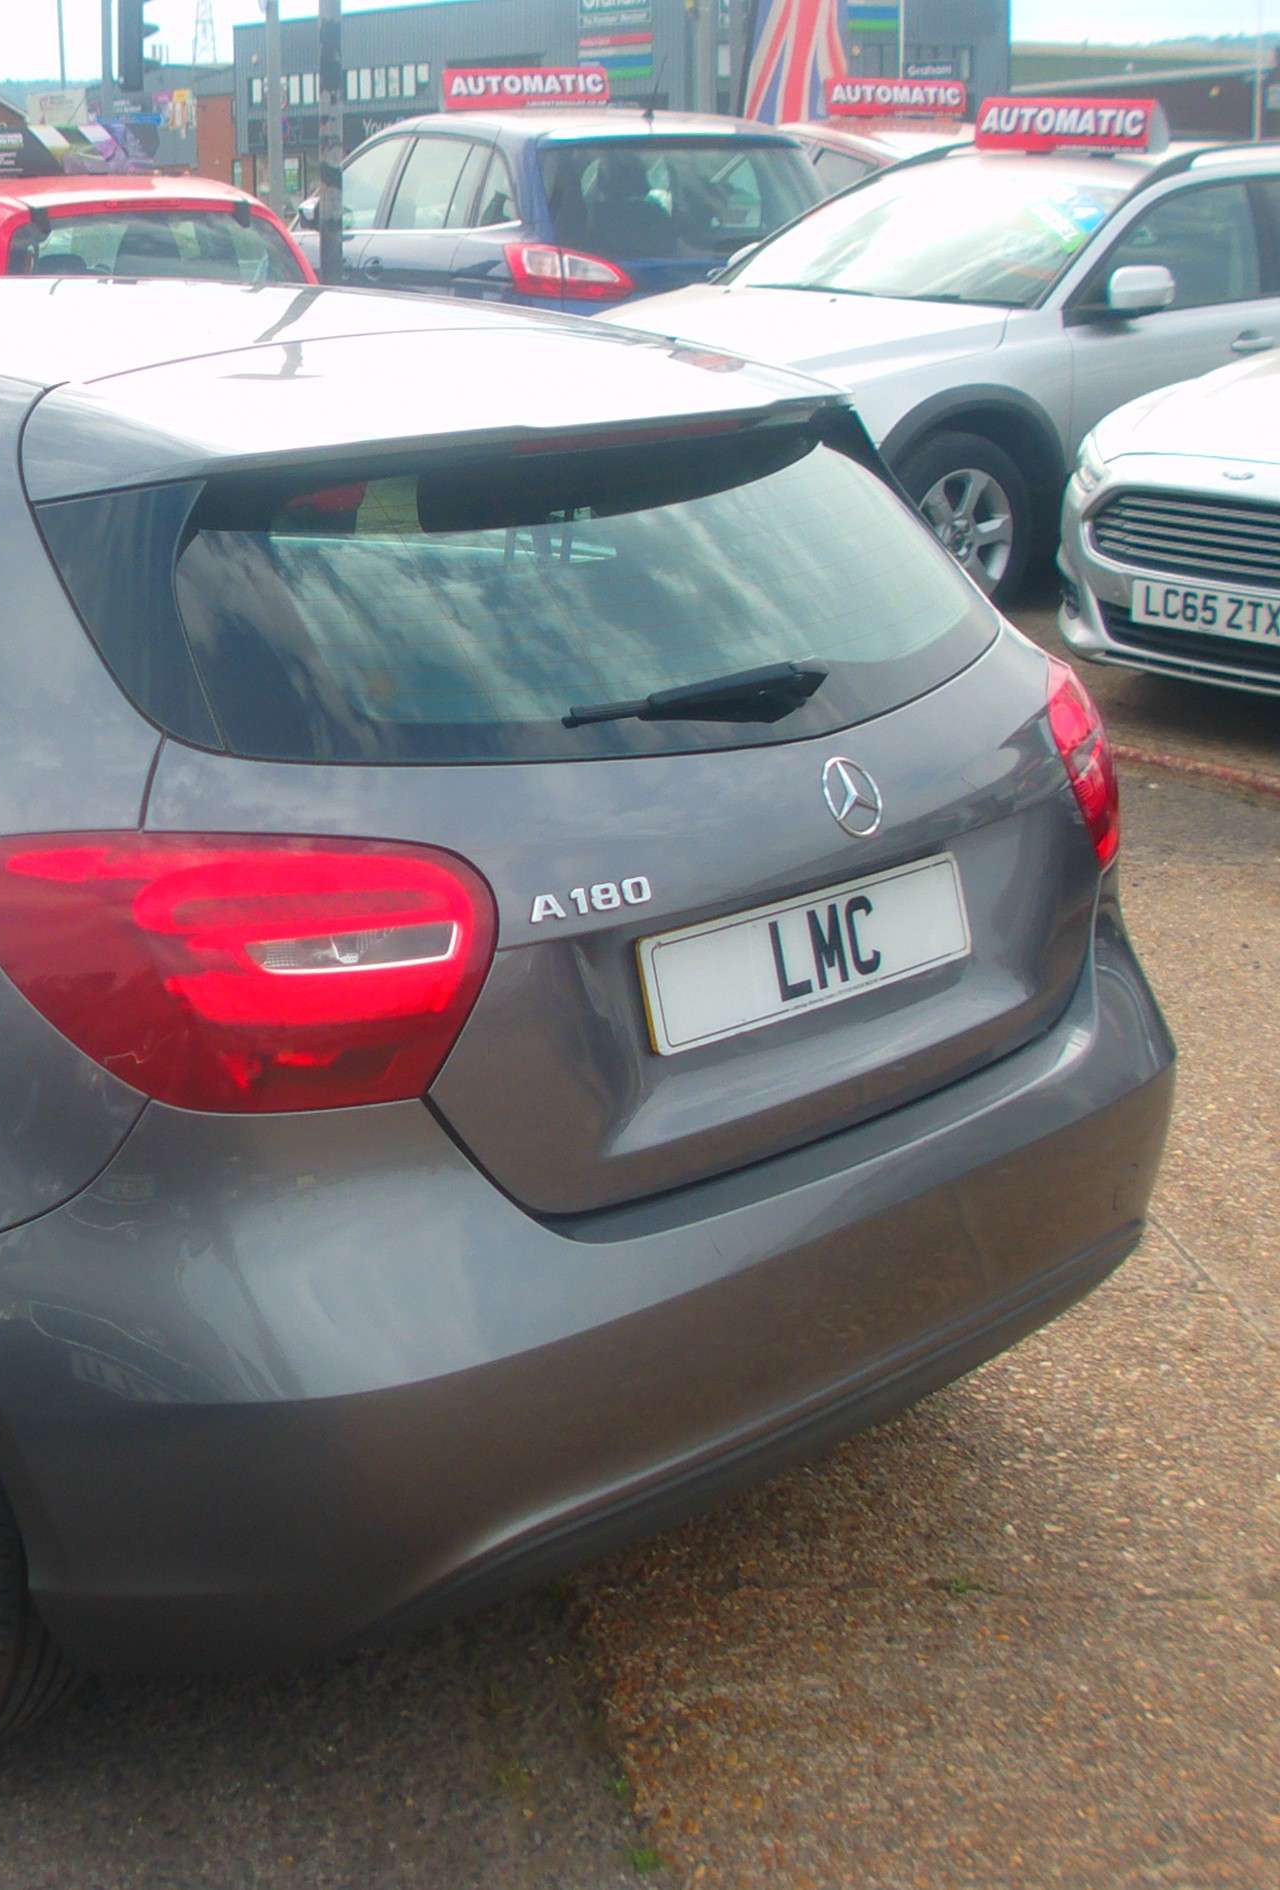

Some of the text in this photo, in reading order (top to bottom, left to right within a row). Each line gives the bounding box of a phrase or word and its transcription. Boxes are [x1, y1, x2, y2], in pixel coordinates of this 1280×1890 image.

[451, 74, 604, 96] AUTOMATIC
[832, 84, 961, 105] AUTOMATIC
[981, 106, 1145, 136] AUTOMATIC
[1144, 585, 1218, 625] LC65
[531, 876, 652, 924] A 180
[768, 895, 882, 1002] LMC
